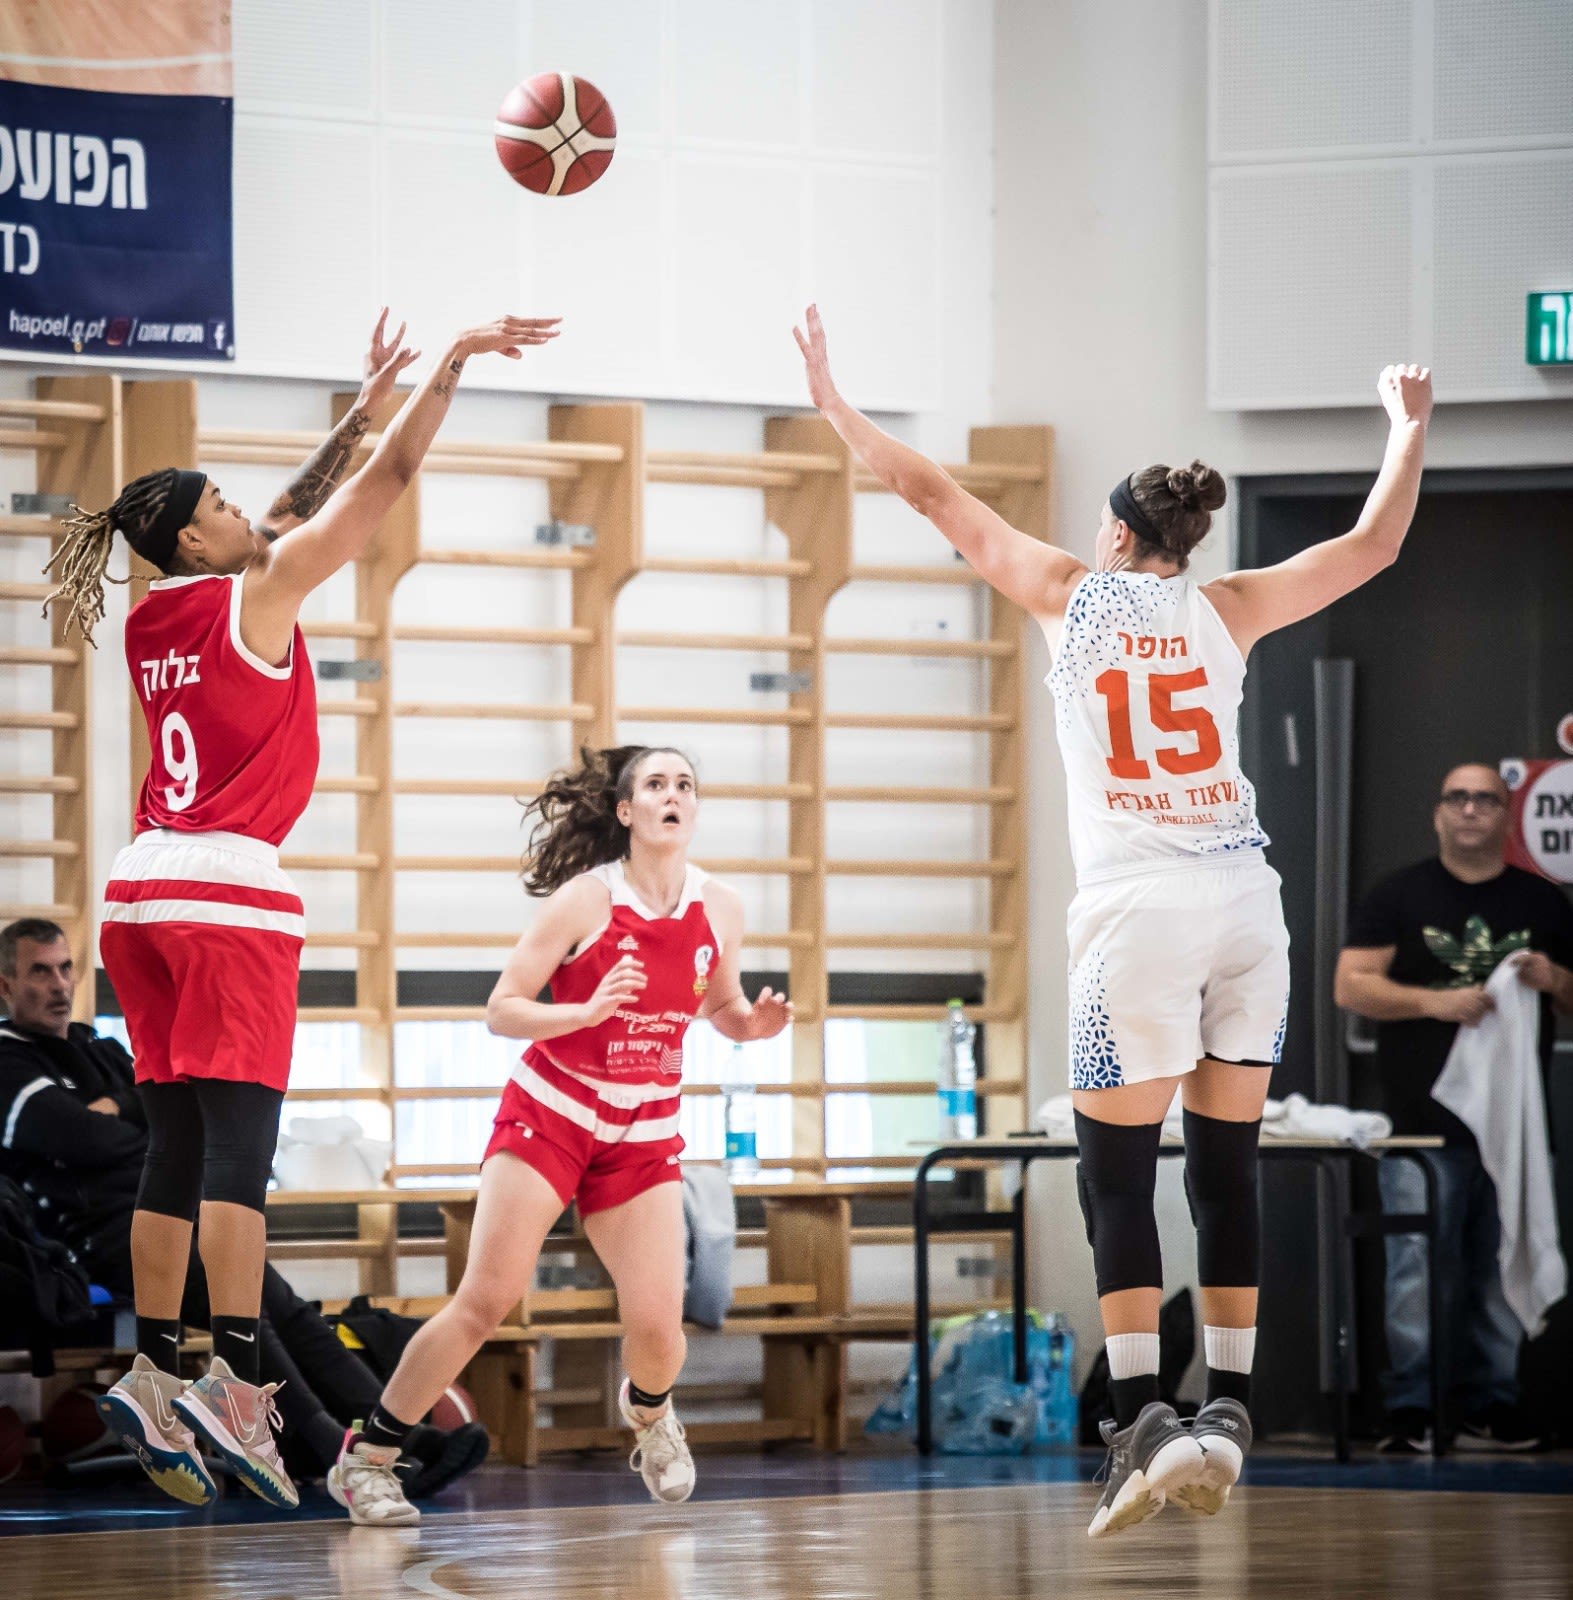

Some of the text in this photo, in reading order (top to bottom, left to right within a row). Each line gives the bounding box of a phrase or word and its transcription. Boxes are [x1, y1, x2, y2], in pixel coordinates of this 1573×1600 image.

[141, 648, 200, 701] בלוק
[1117, 631, 1187, 659] הופר
[161, 711, 199, 812] 9
[1095, 667, 1222, 779] 15
